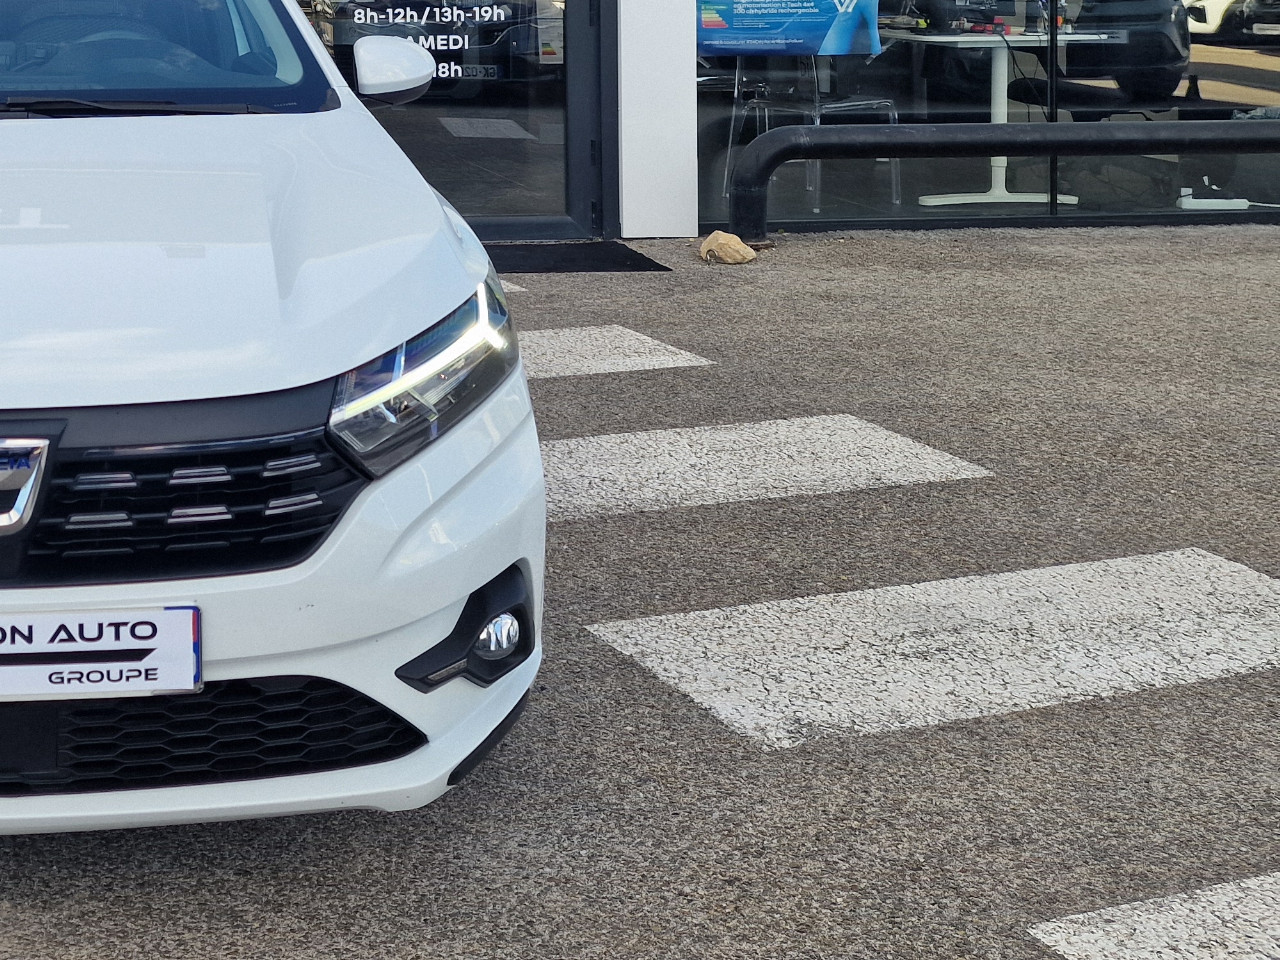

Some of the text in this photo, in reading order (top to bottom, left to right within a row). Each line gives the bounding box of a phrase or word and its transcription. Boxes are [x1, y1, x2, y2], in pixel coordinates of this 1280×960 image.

[353, 7, 418, 24] 8h-12h
[433, 5, 505, 22] 13h-19h
[406, 35, 469, 50] MEDI
[47, 620, 158, 644] AUTO
[48, 667, 159, 685] GROUPE
